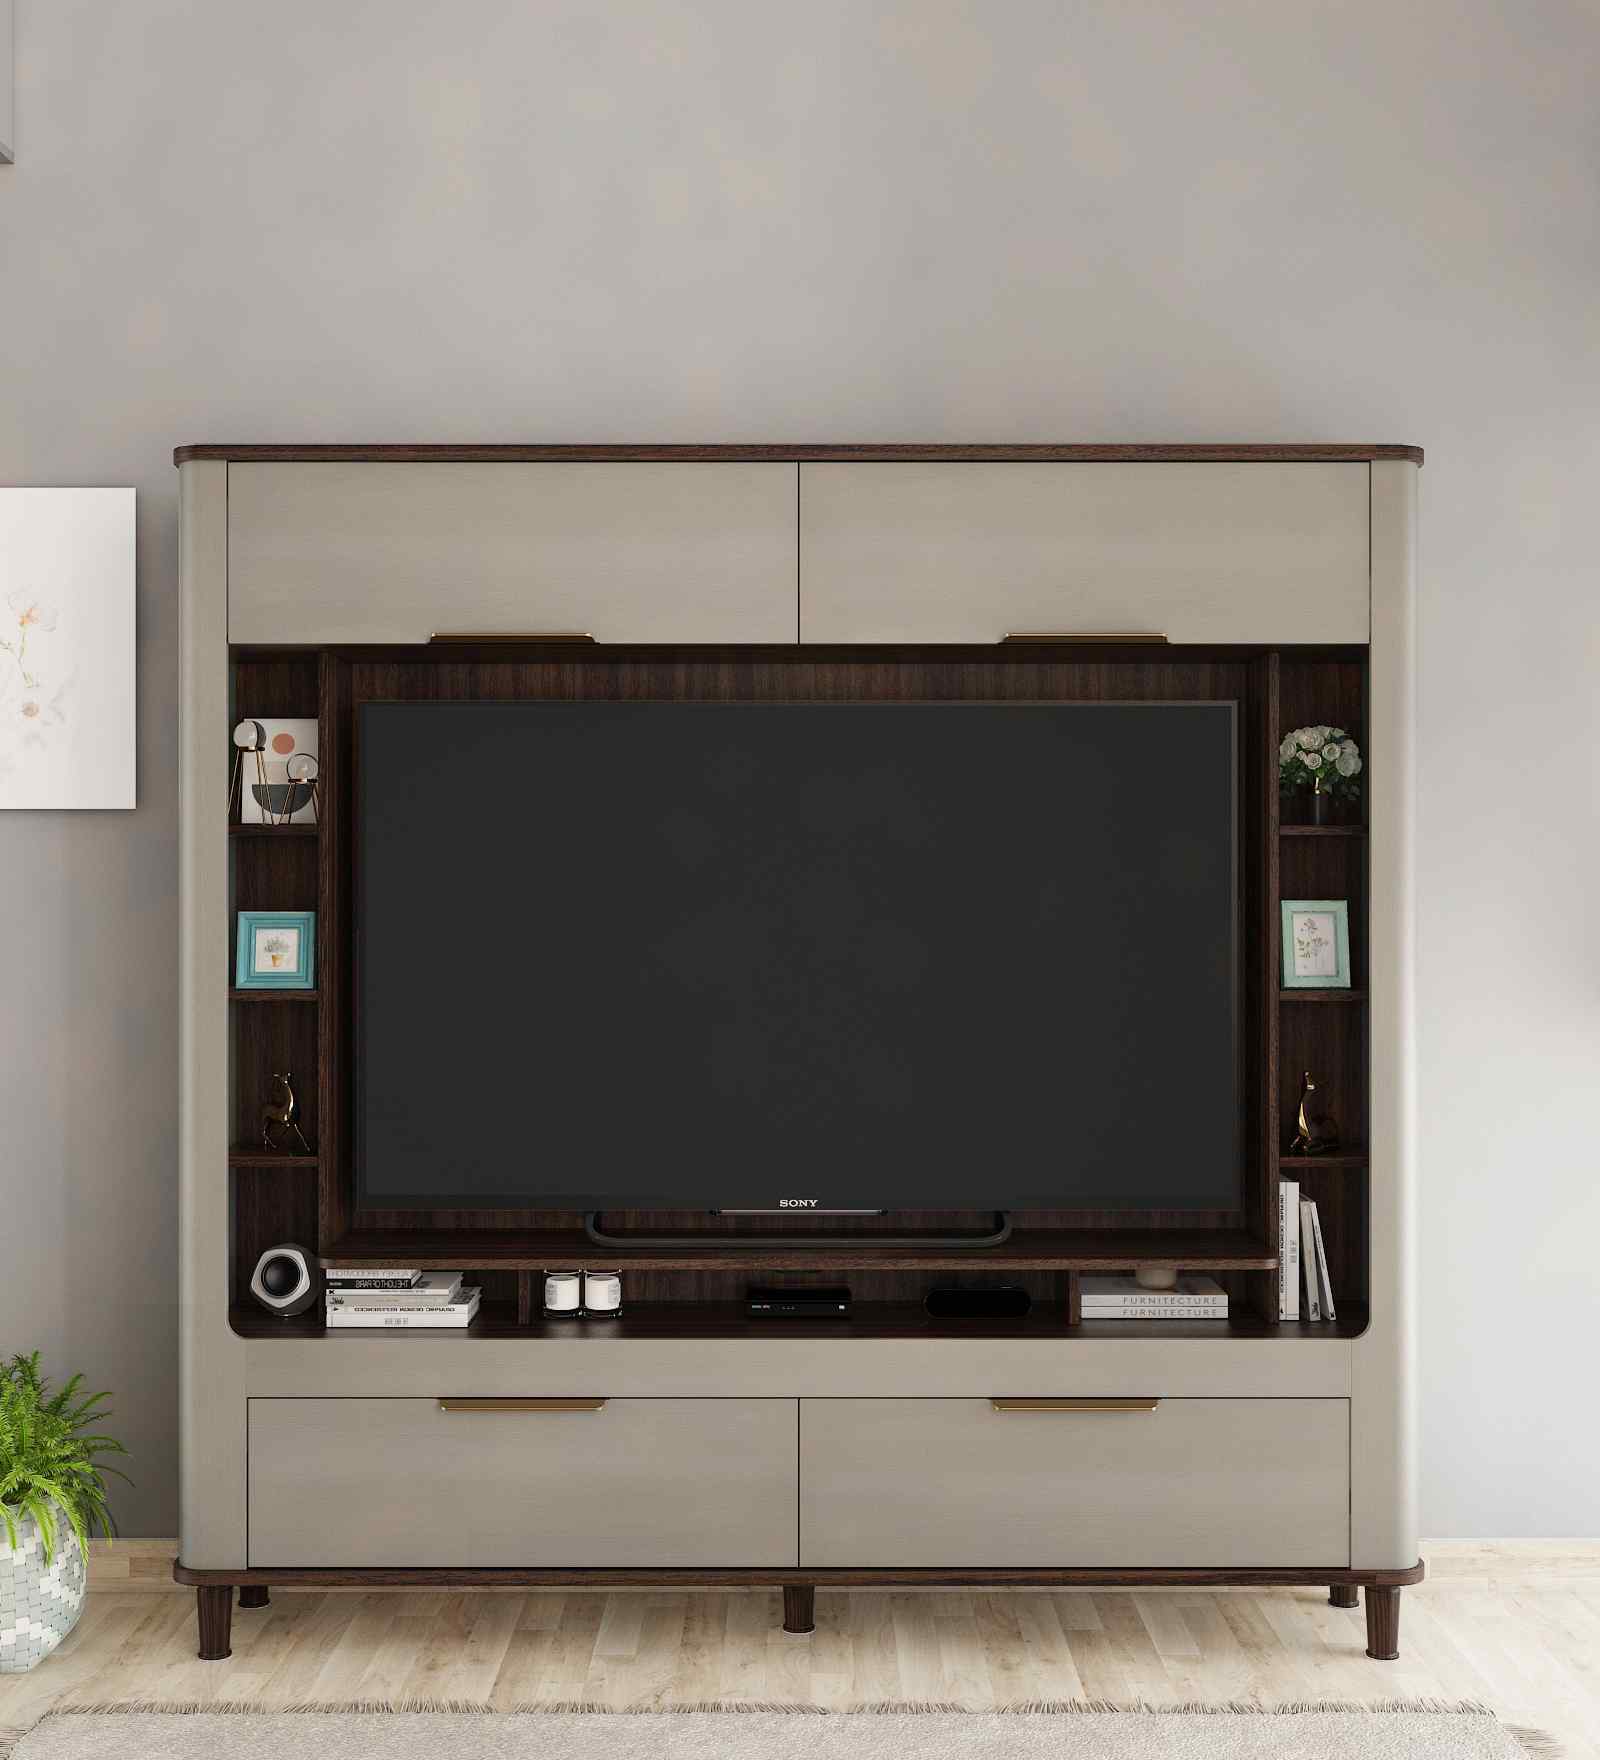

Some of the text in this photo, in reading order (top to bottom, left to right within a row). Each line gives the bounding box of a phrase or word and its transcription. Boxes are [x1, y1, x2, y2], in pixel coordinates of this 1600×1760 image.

[779, 1199, 818, 1208] SONY
[1122, 1296, 1217, 1305] FURNITECTURE
[1122, 1309, 1217, 1317] FURNITECTURE
